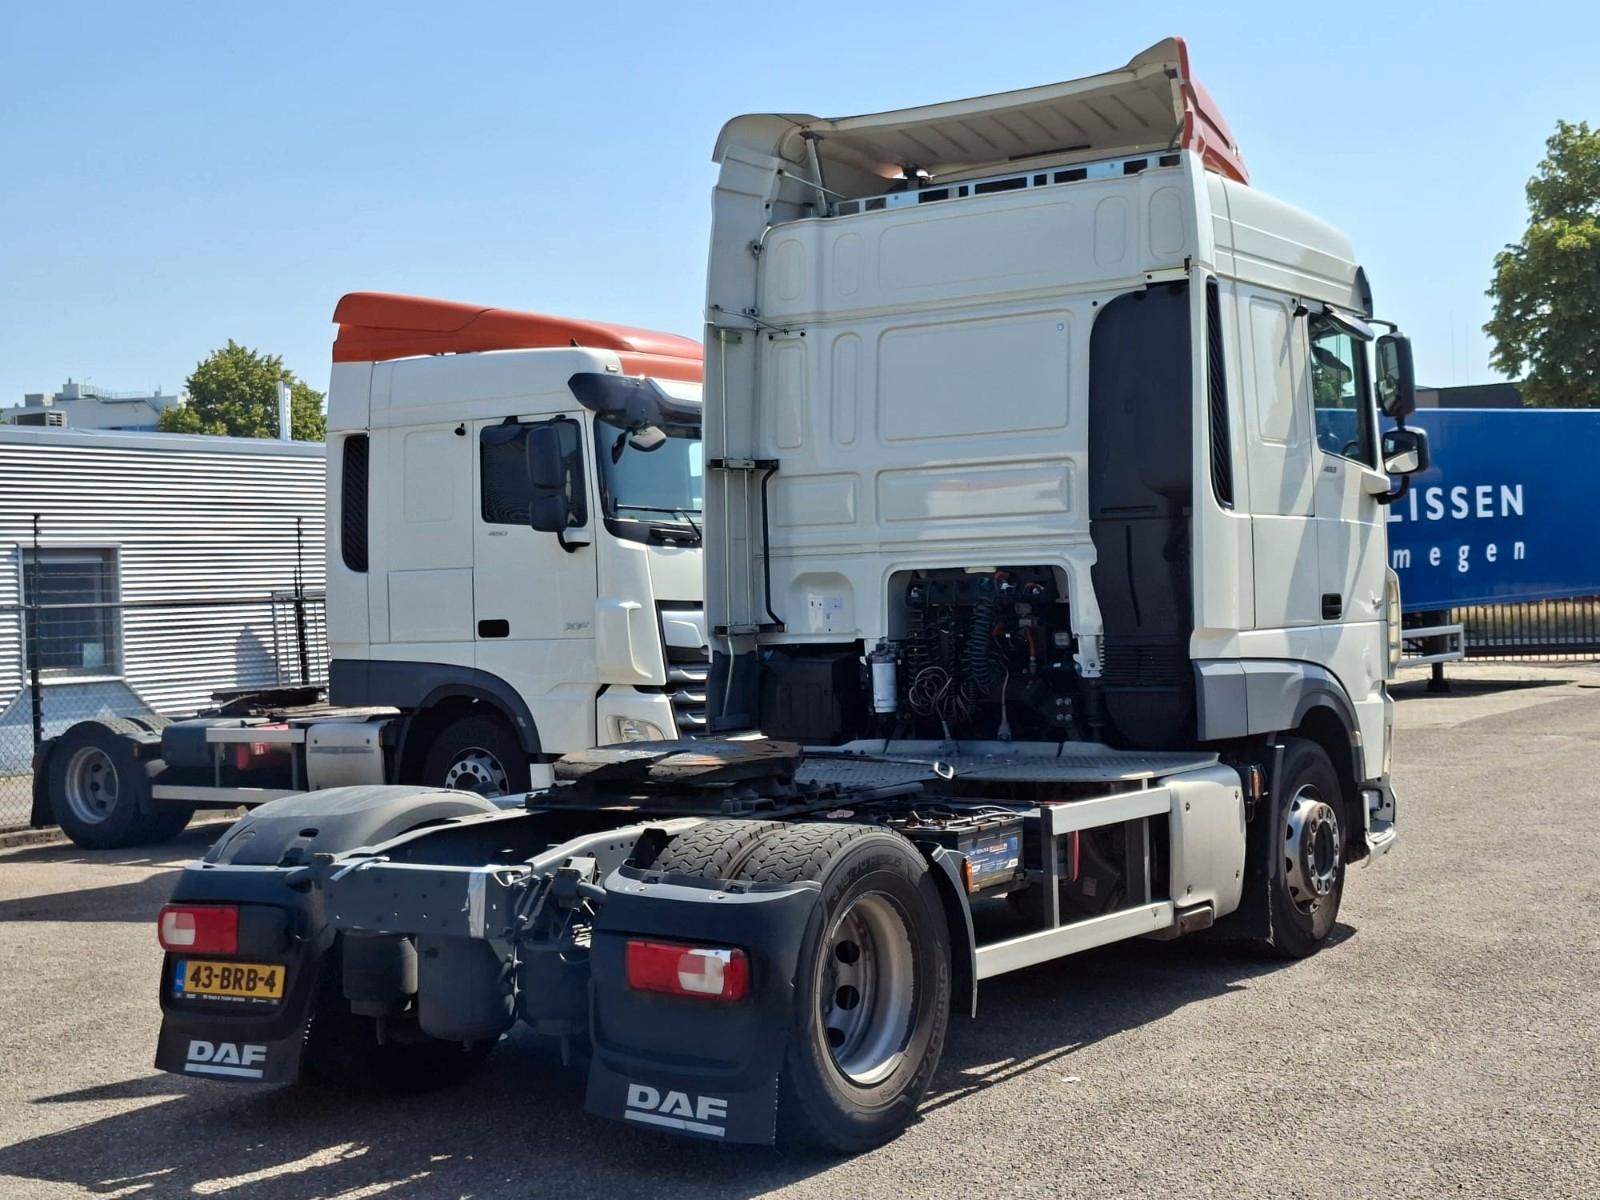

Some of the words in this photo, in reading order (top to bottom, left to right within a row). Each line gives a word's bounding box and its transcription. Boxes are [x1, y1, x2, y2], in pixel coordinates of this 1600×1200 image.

[190, 965, 276, 993] 43-BRB-4
[187, 1040, 267, 1065] DAF
[626, 1083, 728, 1120] DAF
